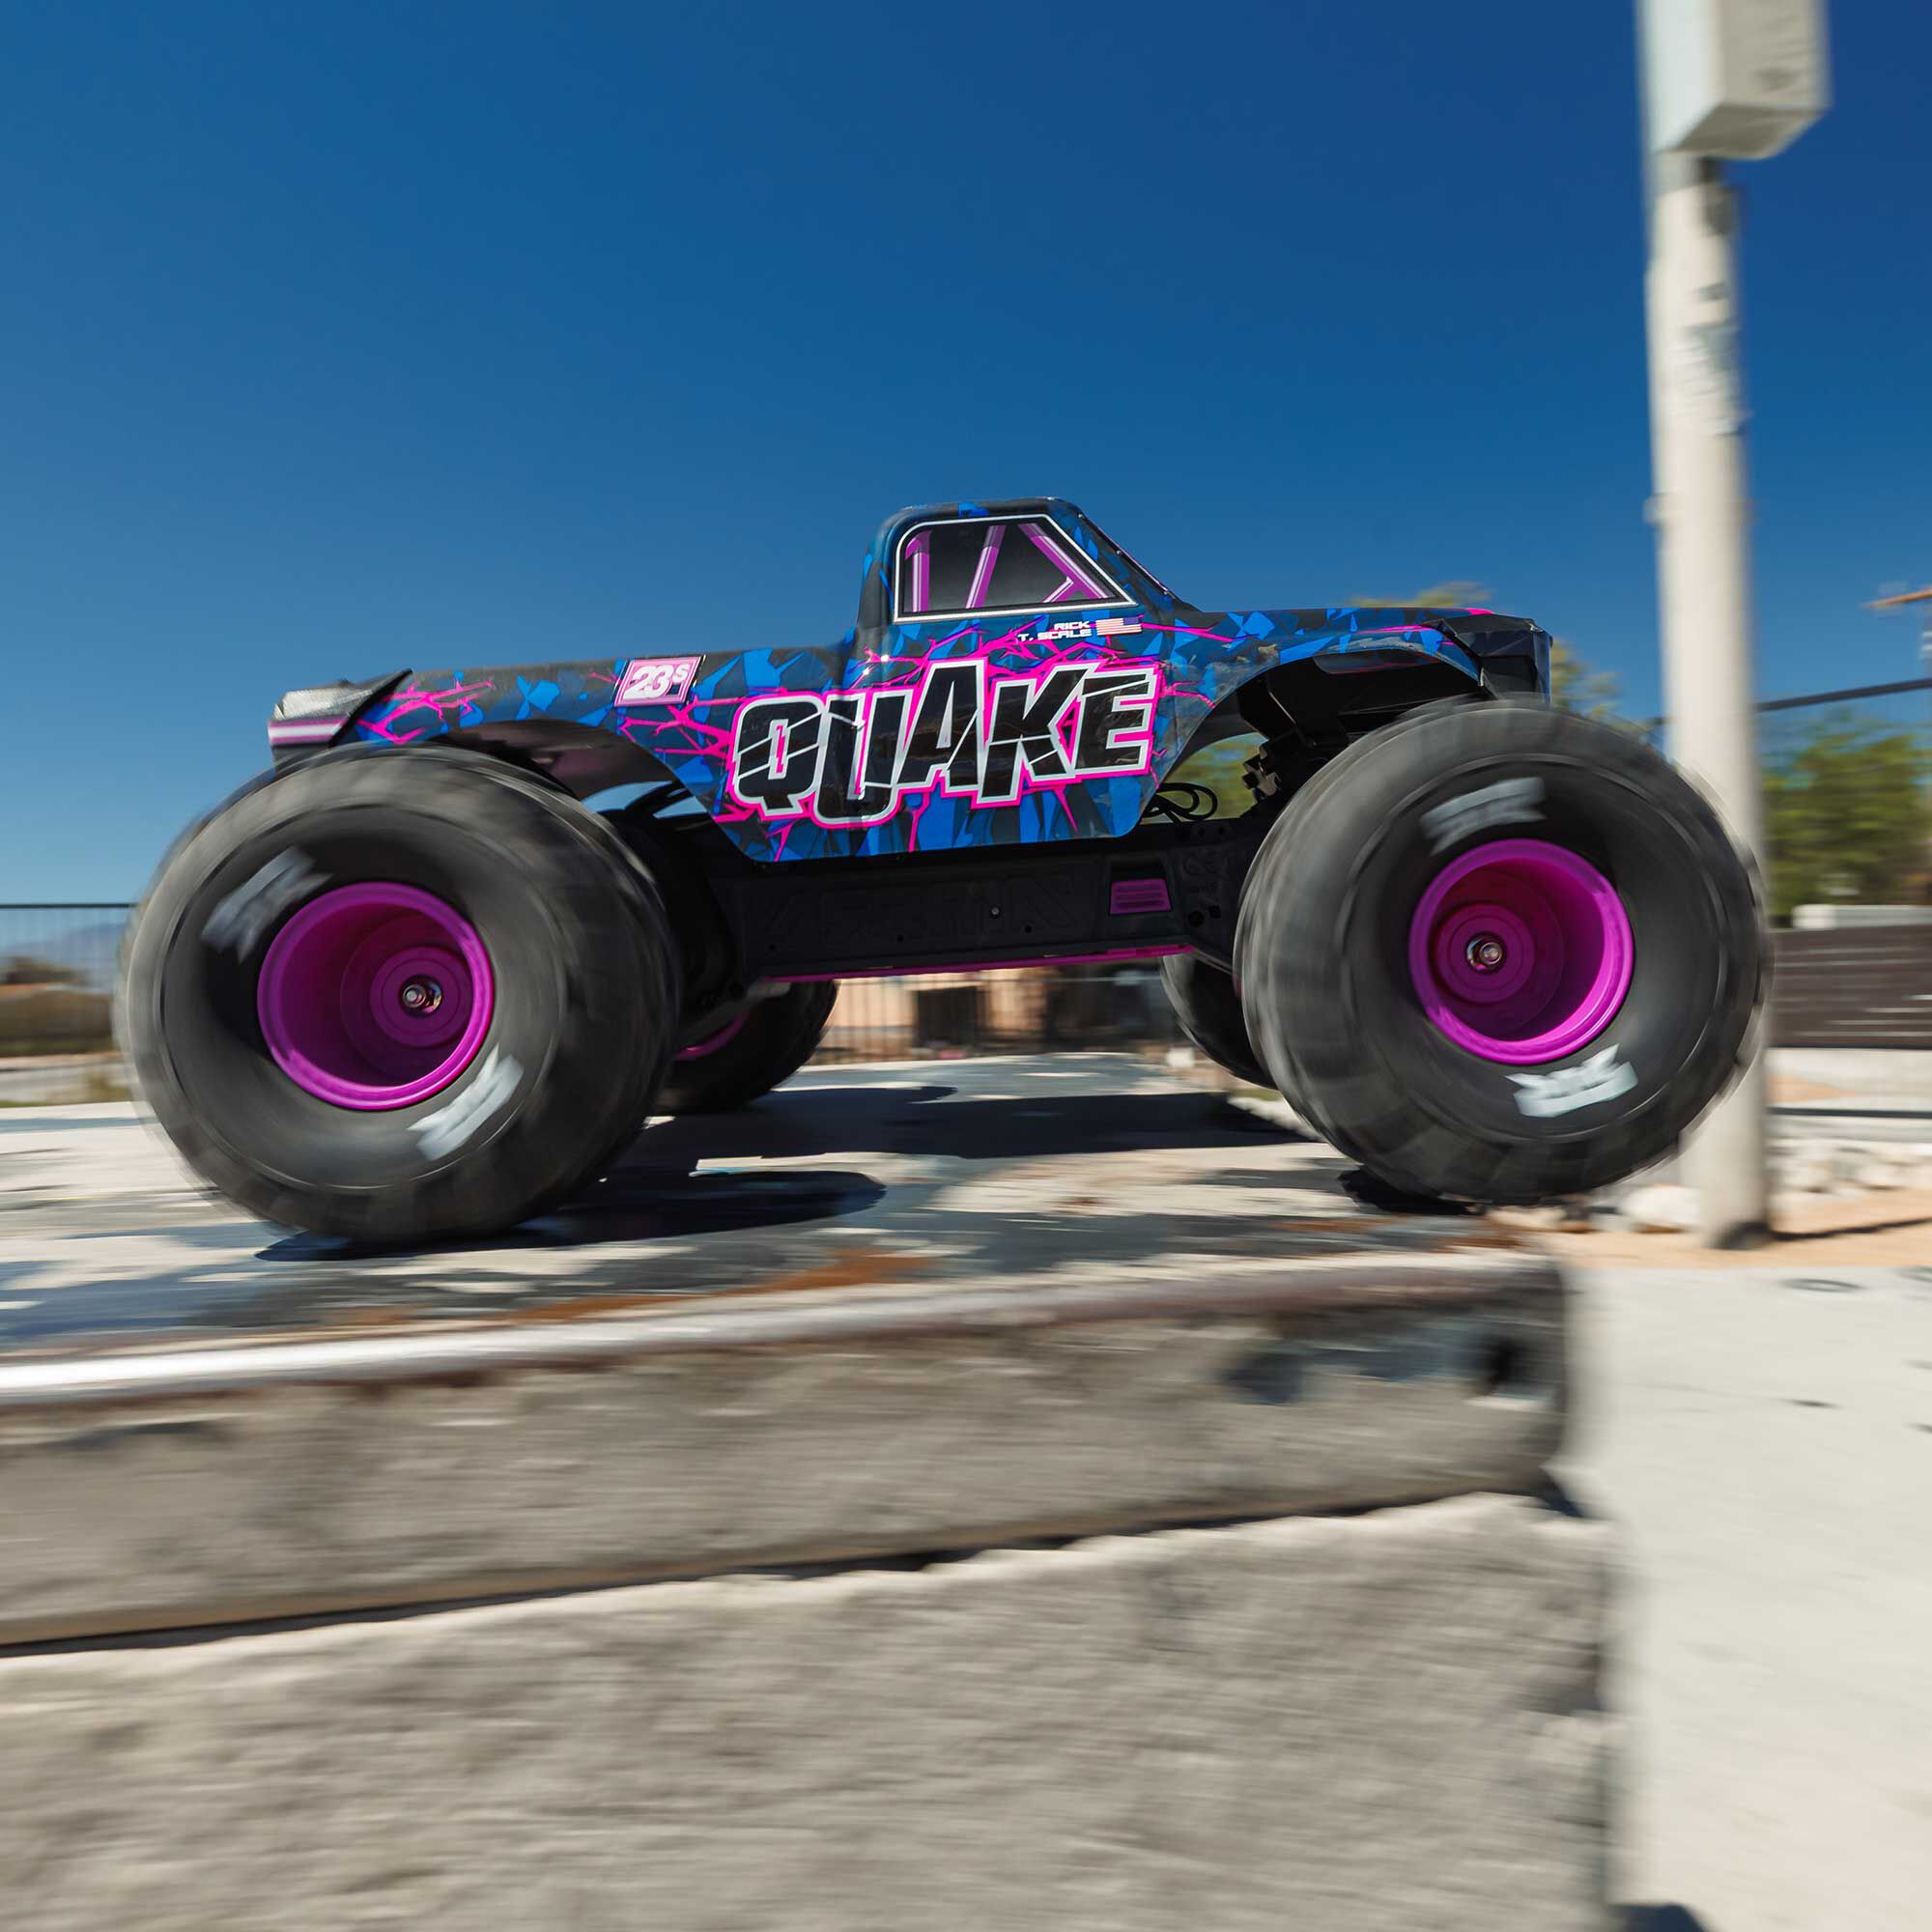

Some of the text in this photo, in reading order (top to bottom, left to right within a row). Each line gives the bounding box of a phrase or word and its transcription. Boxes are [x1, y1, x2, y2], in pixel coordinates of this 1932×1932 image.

[1054, 621, 1091, 631] RICK
[1037, 629, 1092, 640] SCALE
[731, 658, 1158, 824] QUAKE
